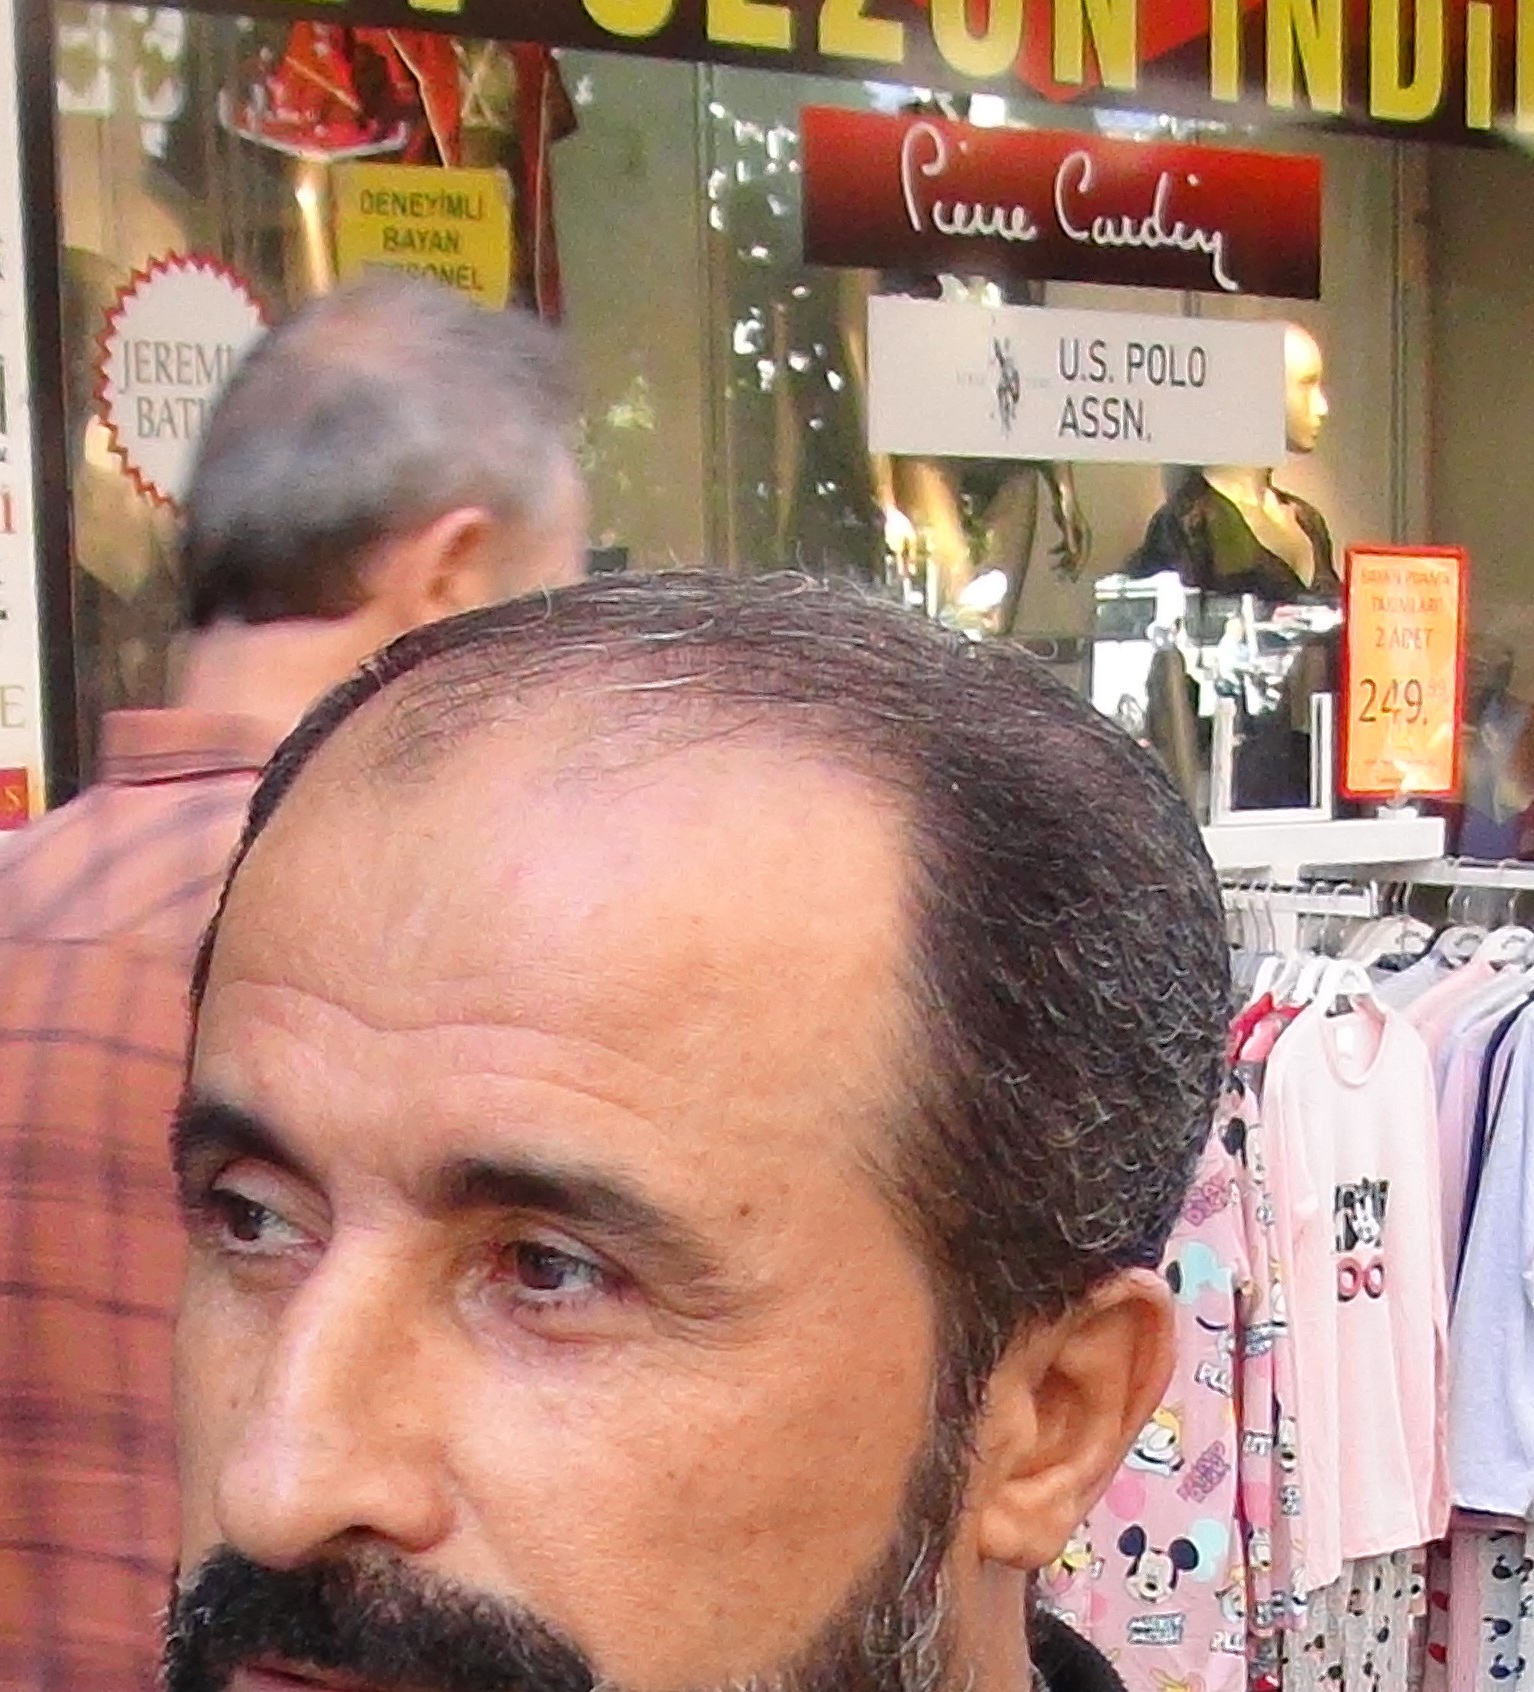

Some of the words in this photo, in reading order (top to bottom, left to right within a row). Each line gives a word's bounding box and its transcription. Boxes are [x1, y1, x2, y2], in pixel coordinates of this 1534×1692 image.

[901, 121, 1038, 241] Pierre
[1054, 150, 1240, 291] Cardin
[1058, 337, 1115, 384] U.S.
[1124, 341, 1207, 388] POLO
[1058, 396, 1153, 443] ASSN.
